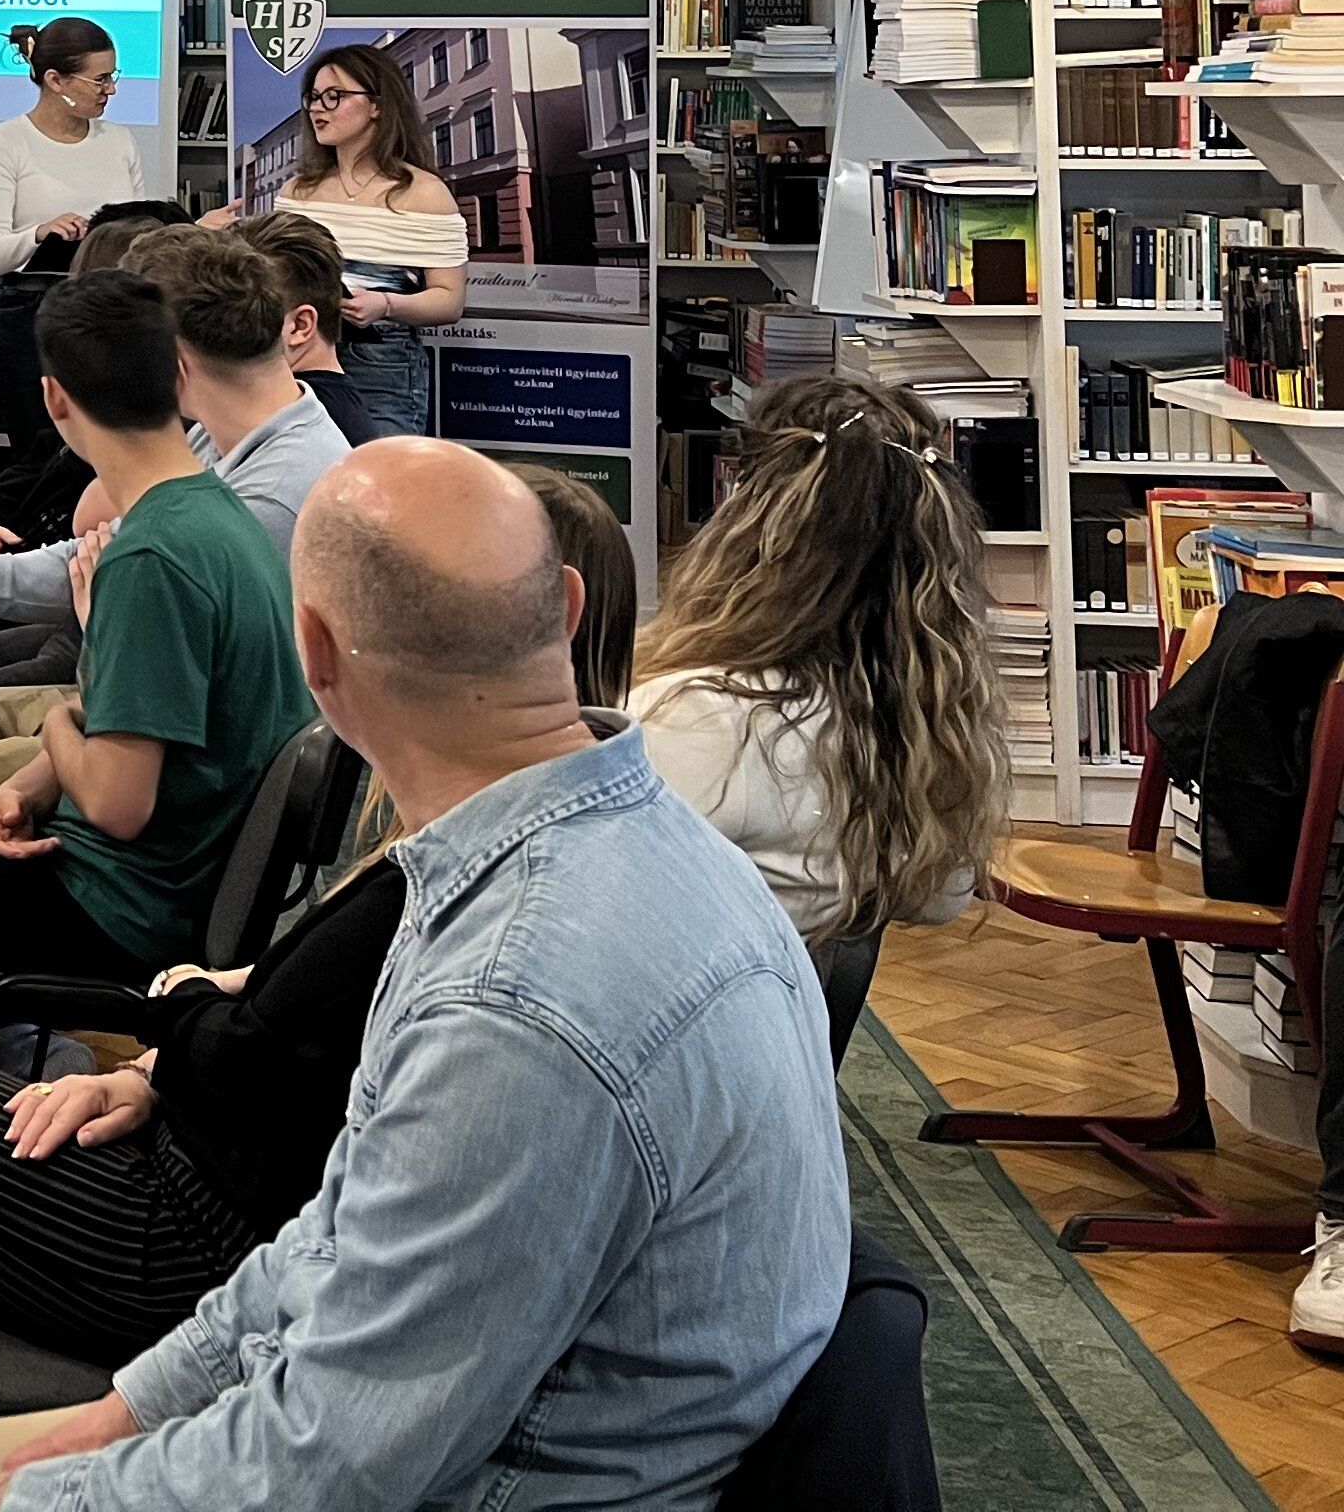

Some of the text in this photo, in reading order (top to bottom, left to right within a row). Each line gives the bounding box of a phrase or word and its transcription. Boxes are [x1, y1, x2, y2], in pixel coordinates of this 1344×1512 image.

[443, 326, 498, 340] oktatás:
[451, 362, 500, 375] Pénzügyi
[508, 366, 563, 378] számviteli
[565, 369, 619, 381] ügyintéző
[514, 379, 554, 389] szakma
[450, 400, 621, 419] Vállalkozási ügyviteli ügyintéző
[514, 418, 555, 428] szakma
[568, 469, 610, 481] tesztelő
